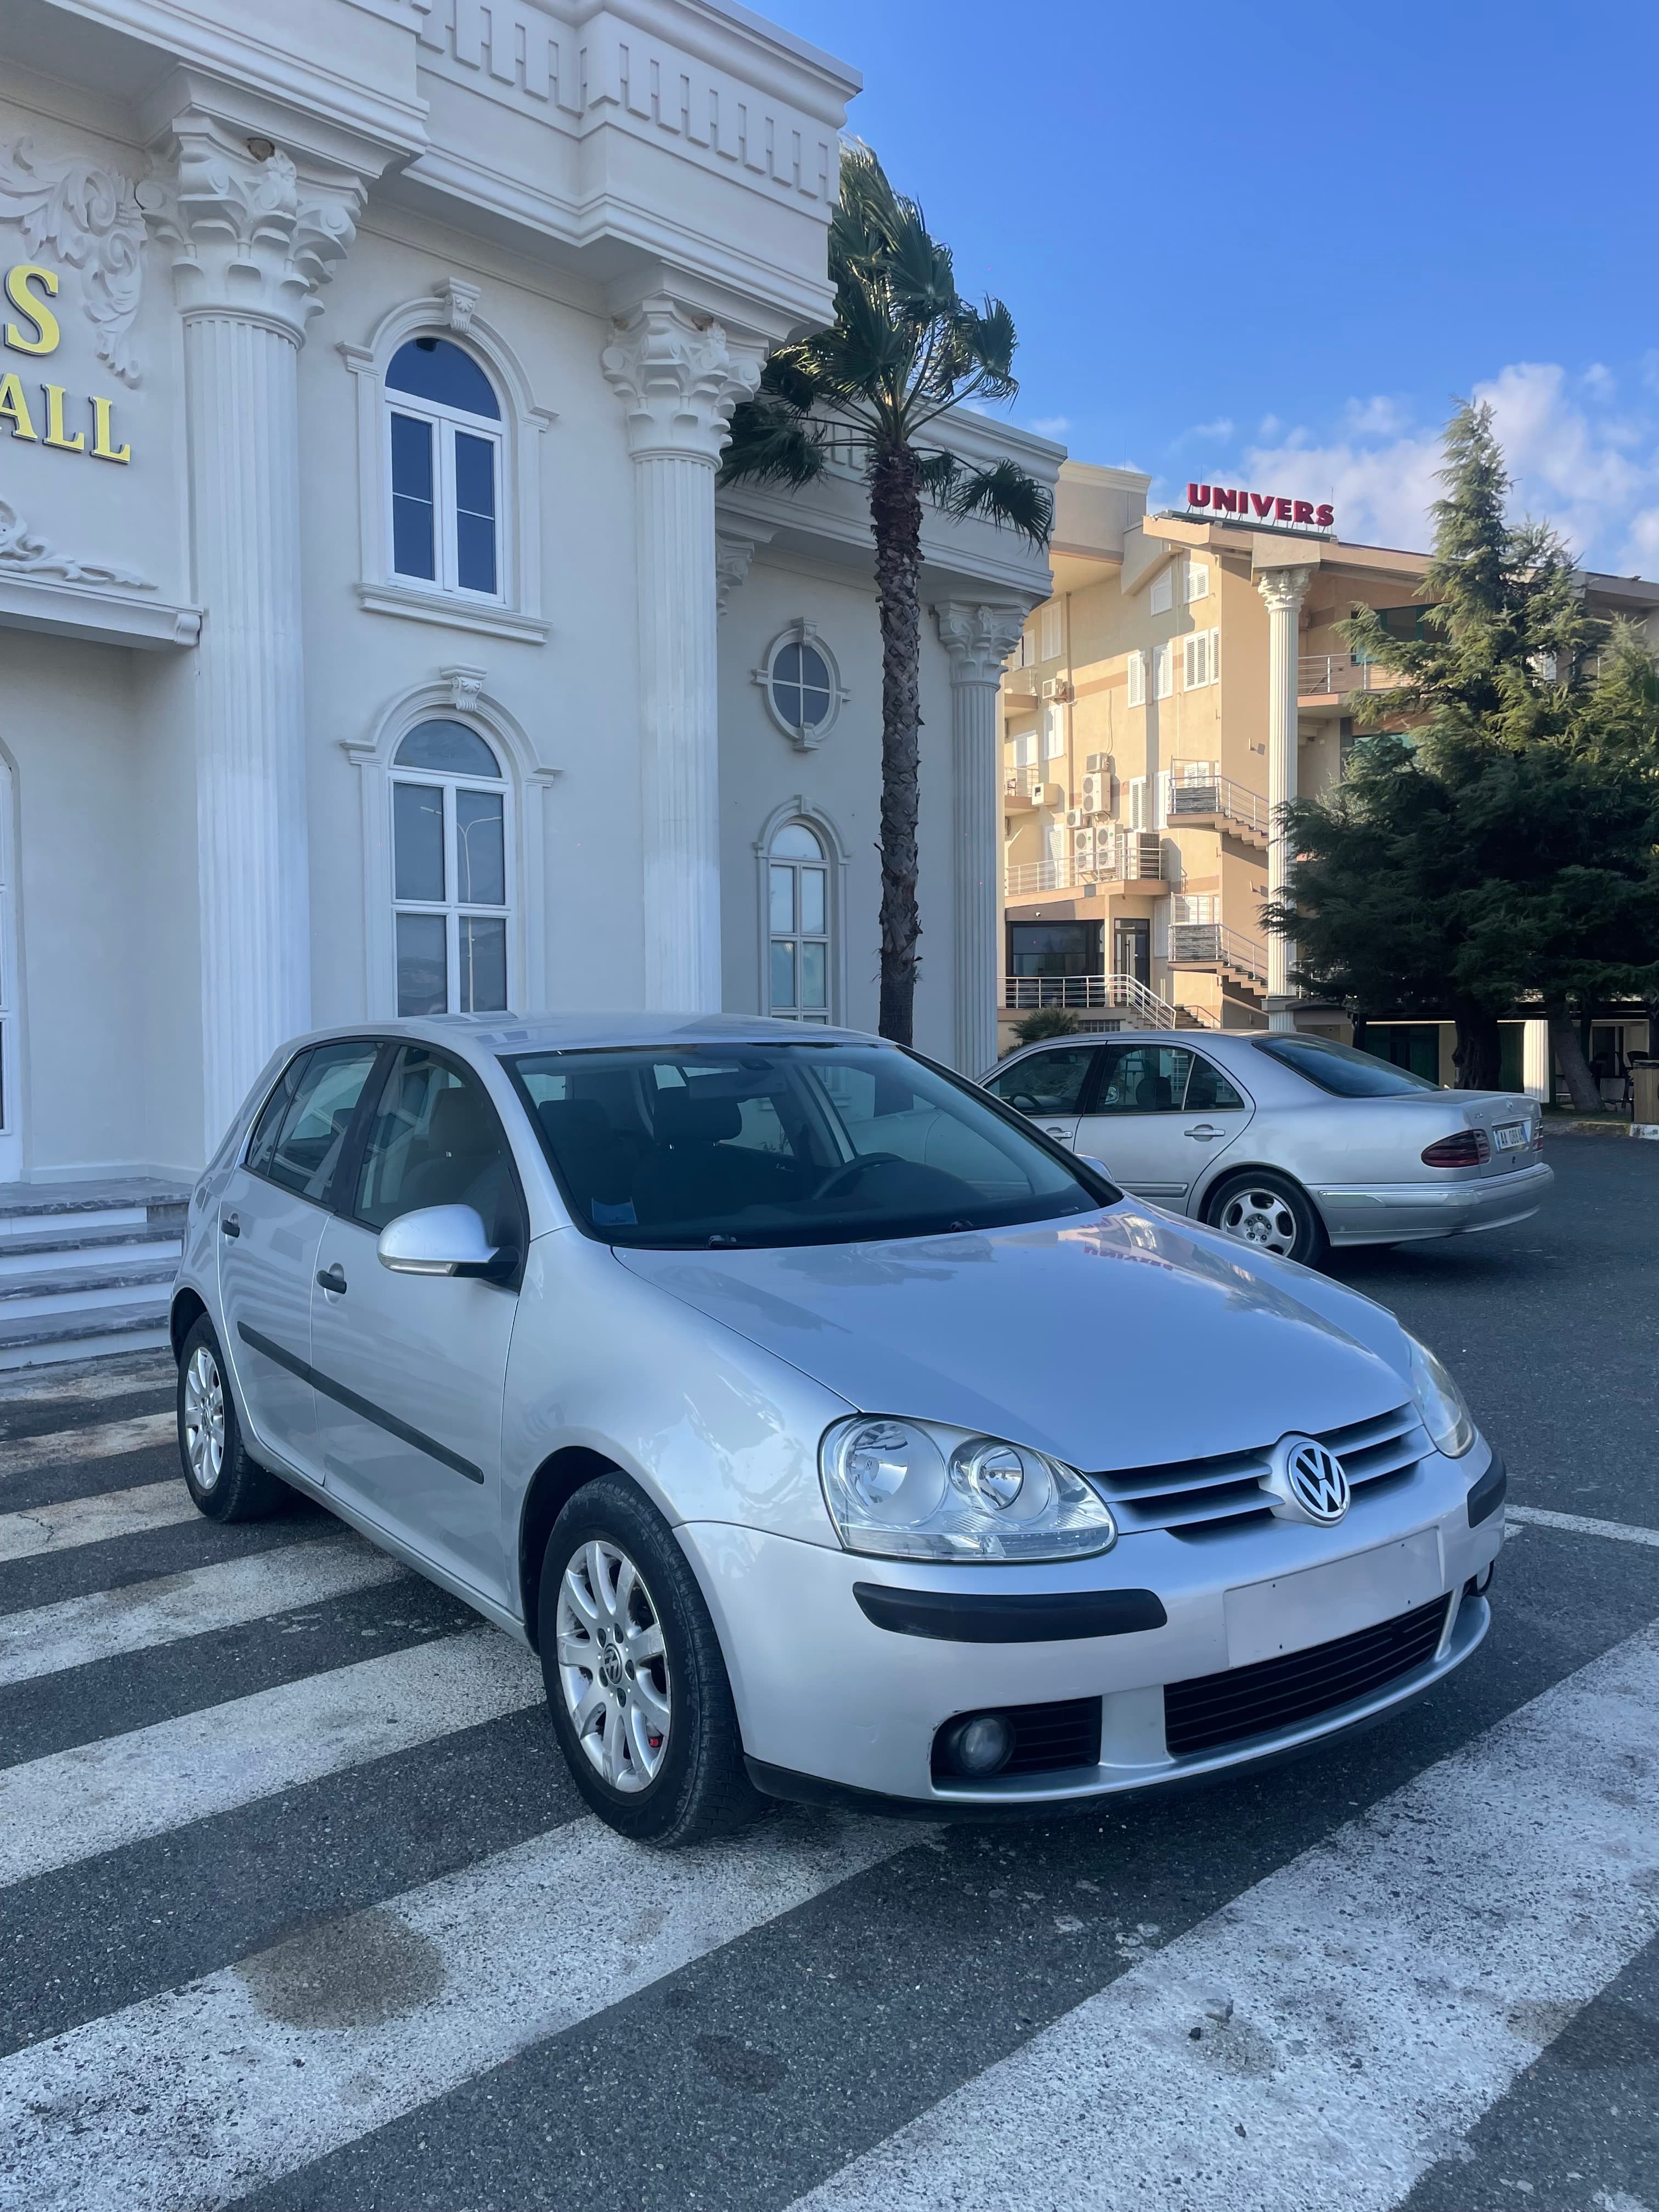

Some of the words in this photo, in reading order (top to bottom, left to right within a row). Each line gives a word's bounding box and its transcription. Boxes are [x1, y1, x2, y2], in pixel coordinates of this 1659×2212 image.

[4, 264, 60, 356] S
[1187, 483, 1334, 527] UNIVERS
[1288, 1442, 1348, 1519] VW
